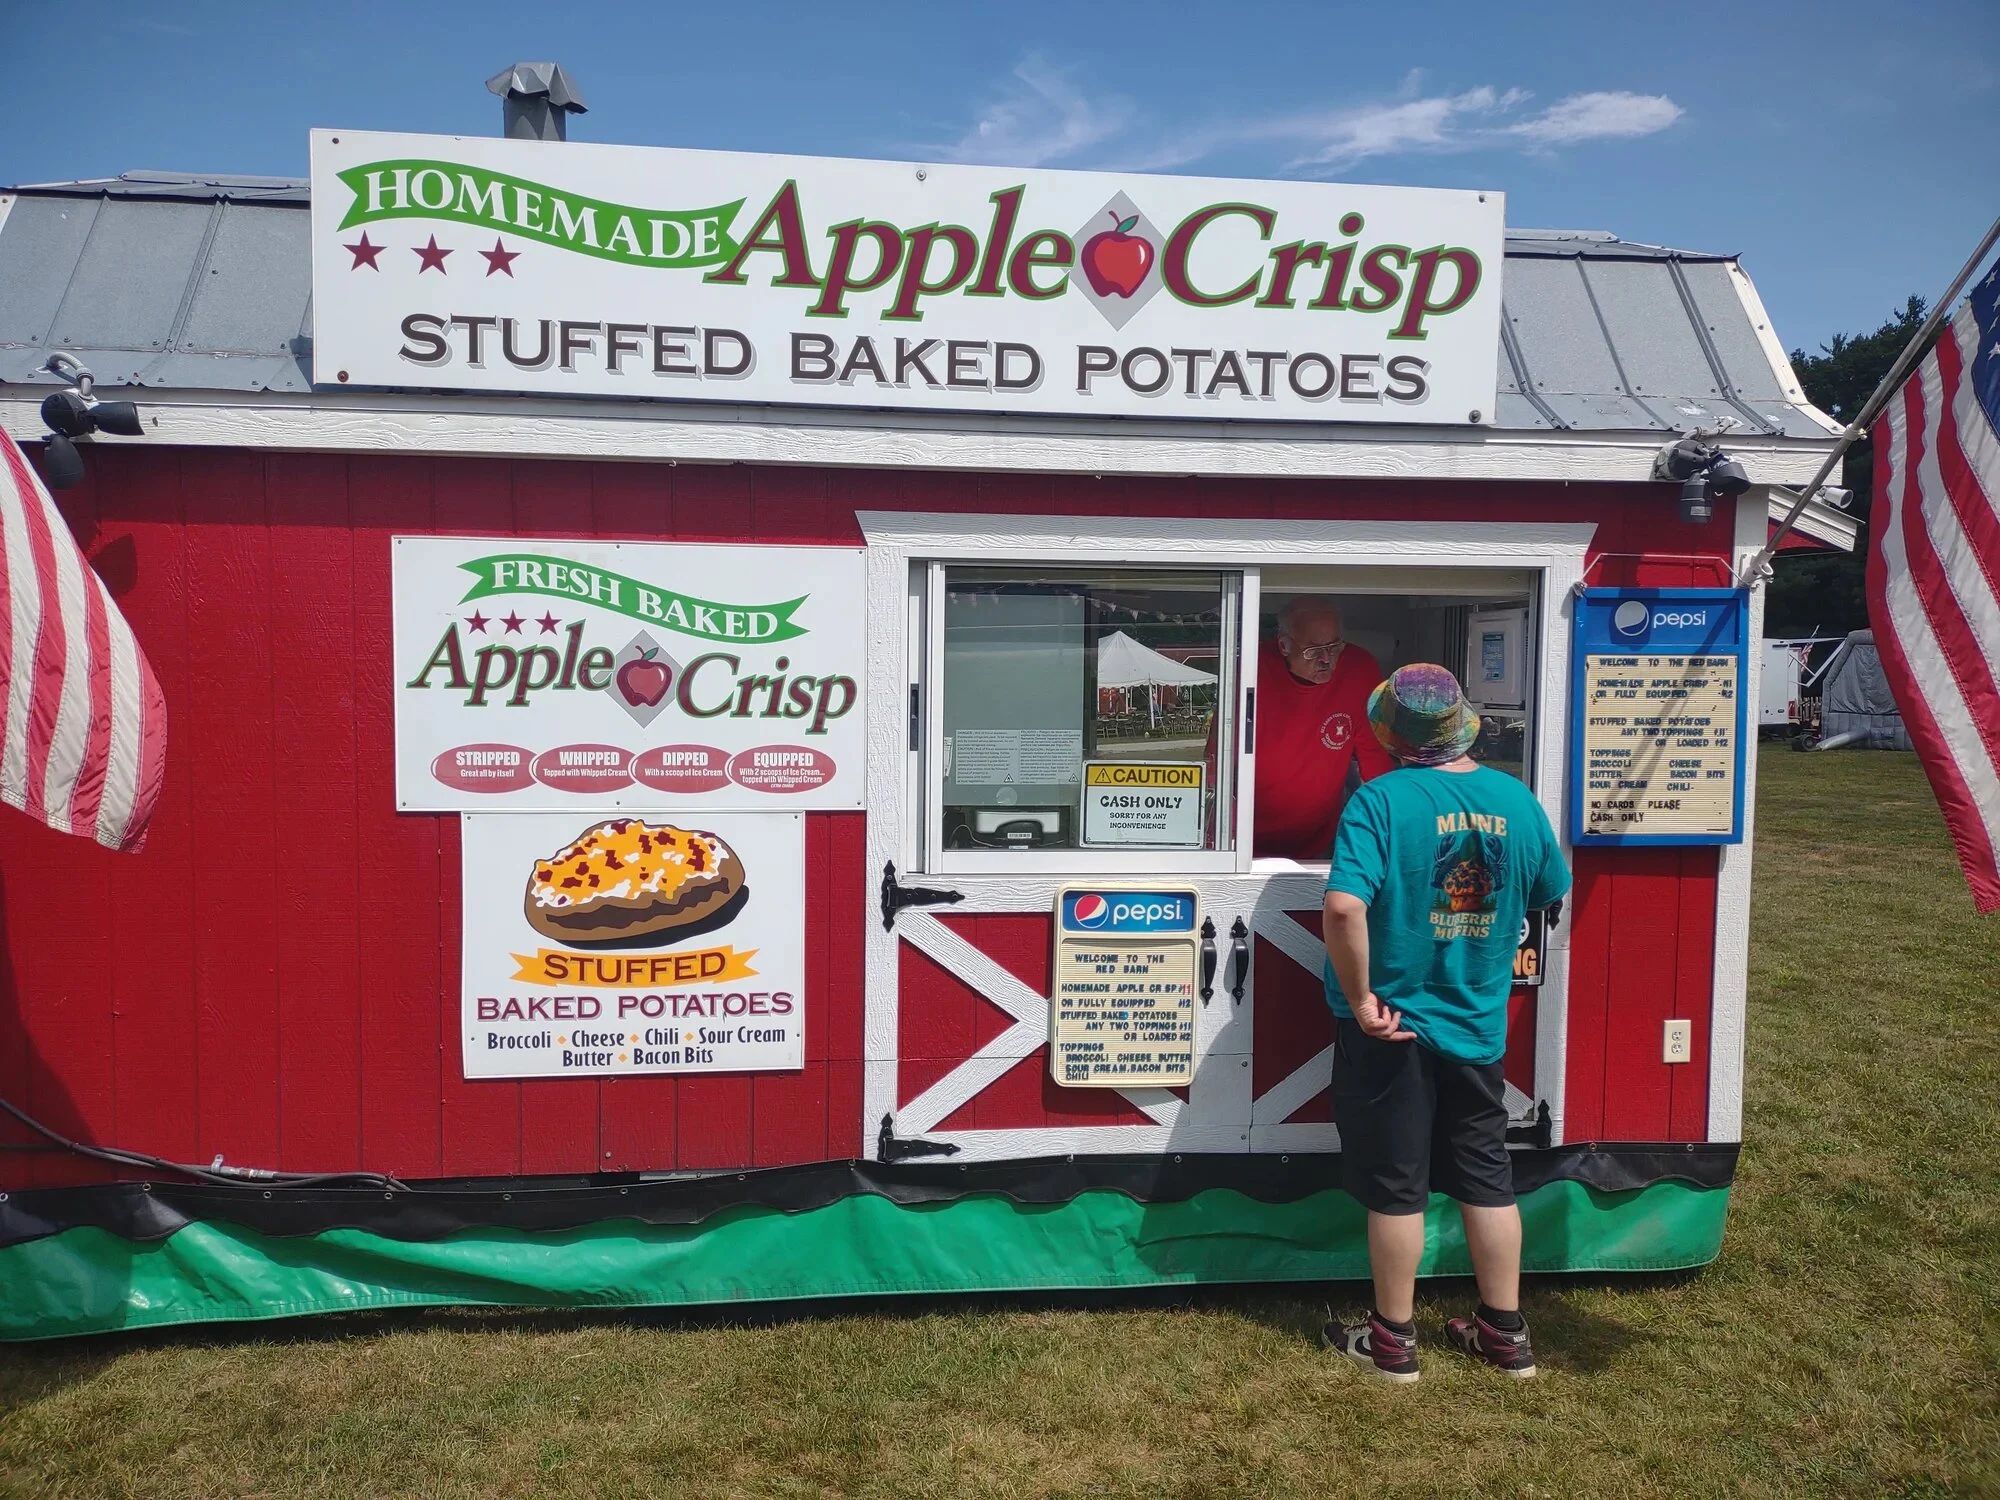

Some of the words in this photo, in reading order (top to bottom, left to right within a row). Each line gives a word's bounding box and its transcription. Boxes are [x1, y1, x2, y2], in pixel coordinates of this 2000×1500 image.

[364, 168, 721, 259] HOMEMADE
[702, 178, 1075, 322] Apple
[1160, 202, 1482, 341] Crisp
[398, 313, 757, 381] STUFFED
[789, 332, 1044, 393] BAKED
[1076, 344, 1431, 405] POTATOES
[491, 560, 620, 607] FRESH
[635, 586, 778, 640] BAKED
[1653, 611, 1706, 628] pepsi
[1600, 658, 1639, 667] WELCOME
[1648, 658, 1659, 667] TO
[1669, 658, 1683, 667] THE
[1689, 658, 1705, 667] RED
[1707, 658, 1729, 667] BARN
[406, 619, 616, 707] Apple
[676, 652, 858, 735] Crisp
[1651, 679, 1678, 688] APPLE
[1683, 679, 1708, 688] CRISP
[1596, 690, 1606, 698] OR
[1615, 690, 1637, 698] FULLY
[1646, 690, 1687, 698] EQUIPPED
[1590, 717, 1627, 726] STUFFED
[1634, 717, 1661, 726] BAKED
[1668, 717, 1711, 726] POTATOES
[1621, 728, 1638, 736] ANY
[1642, 728, 1660, 736] TWO
[1661, 728, 1704, 736] TOPPINGS
[1655, 739, 1666, 747] OR
[1677, 739, 1709, 747] LOADED
[1590, 749, 1631, 757] TOPPINGS
[456, 751, 521, 766] STRIPPED
[559, 751, 620, 766] WHIPPED
[662, 751, 709, 766] DIPPED
[753, 752, 814, 768] EQUIPPED
[1590, 760, 1632, 768] BROCCOLI
[1669, 760, 1702, 768] CHEESE
[460, 768, 478, 777] Great
[479, 768, 488, 777] all
[488, 768, 496, 778] by
[497, 768, 514, 777] itself
[543, 768, 565, 777] Topped
[566, 768, 580, 777] with
[581, 768, 607, 778] Whipped
[607, 769, 628, 777] Cream
[644, 768, 660, 777] With
[665, 769, 684, 778] scoop
[684, 768, 691, 777] of
[692, 768, 701, 777] Ice
[702, 768, 723, 777] Cream
[739, 768, 754, 776] With
[754, 768, 759, 776] 2
[782, 768, 789, 776] of
[790, 768, 799, 776] Ice
[1113, 769, 1193, 784] CAUTION
[1590, 770, 1622, 778] BUTTER
[1670, 770, 1697, 778] BACON
[1706, 770, 1725, 778] BITS
[742, 776, 762, 784] topped
[777, 776, 802, 784] Whipped
[1590, 781, 1611, 789] SOUR
[1618, 781, 1648, 789] CREAM
[1100, 795, 1140, 808] CASH
[1144, 796, 1182, 809] ONLY
[1591, 801, 1601, 809] NO
[1607, 801, 1634, 809] CARDS
[1648, 800, 1681, 810] PLEASE
[1110, 812, 1135, 820] SORRY
[1136, 812, 1151, 820] FOR
[1590, 813, 1613, 822] CASH
[1622, 813, 1645, 823] ONLY
[1110, 822, 1166, 830] INCONVENIENCE
[1436, 812, 1507, 836] MAINE
[1113, 900, 1182, 925] pepsi
[1075, 954, 1118, 963] WELCOME
[1127, 955, 1138, 963] TO
[1147, 955, 1164, 963] THE
[544, 952, 727, 983] STUFFED
[1096, 965, 1115, 974] RED
[1124, 965, 1148, 974] BARN
[1061, 984, 1110, 992] HOMEMADE
[1116, 984, 1144, 992] APPLE
[476, 996, 602, 1022] BAKED
[617, 991, 795, 1020] POTATOES
[1061, 999, 1073, 1008] OR
[1078, 999, 1106, 1008] FULLY
[1111, 999, 1155, 1008] EQUIPPED
[1060, 1011, 1097, 1020] STUFFED
[1101, 1011, 1128, 1020] BAKED
[1133, 1011, 1177, 1020] POTATOES
[1085, 1022, 1104, 1030] ANY
[1110, 1022, 1129, 1030] TWO
[1134, 1022, 1177, 1030] TOPPINGS
[487, 1031, 551, 1049] Broccoli
[571, 1030, 625, 1047] Cheese
[644, 1028, 679, 1046] Chili
[699, 1027, 735, 1044] Sour
[737, 1026, 786, 1043] Cream
[1124, 1032, 1137, 1041] OR
[1143, 1032, 1177, 1041] LOADED
[1060, 1043, 1104, 1052] TOPPINGS
[562, 1050, 614, 1067] Butter
[633, 1048, 681, 1065] Bacon
[684, 1047, 714, 1064] Bits
[1066, 1053, 1109, 1062] BROCCOLI
[1117, 1053, 1152, 1062] CHEESE
[1158, 1053, 1192, 1062] BUTTER
[1066, 1064, 1089, 1073] SOUR
[1166, 1064, 1185, 1073] BITS
[1405, 1339, 1416, 1347] NIKE
[1513, 1334, 1526, 1343] NIKE
